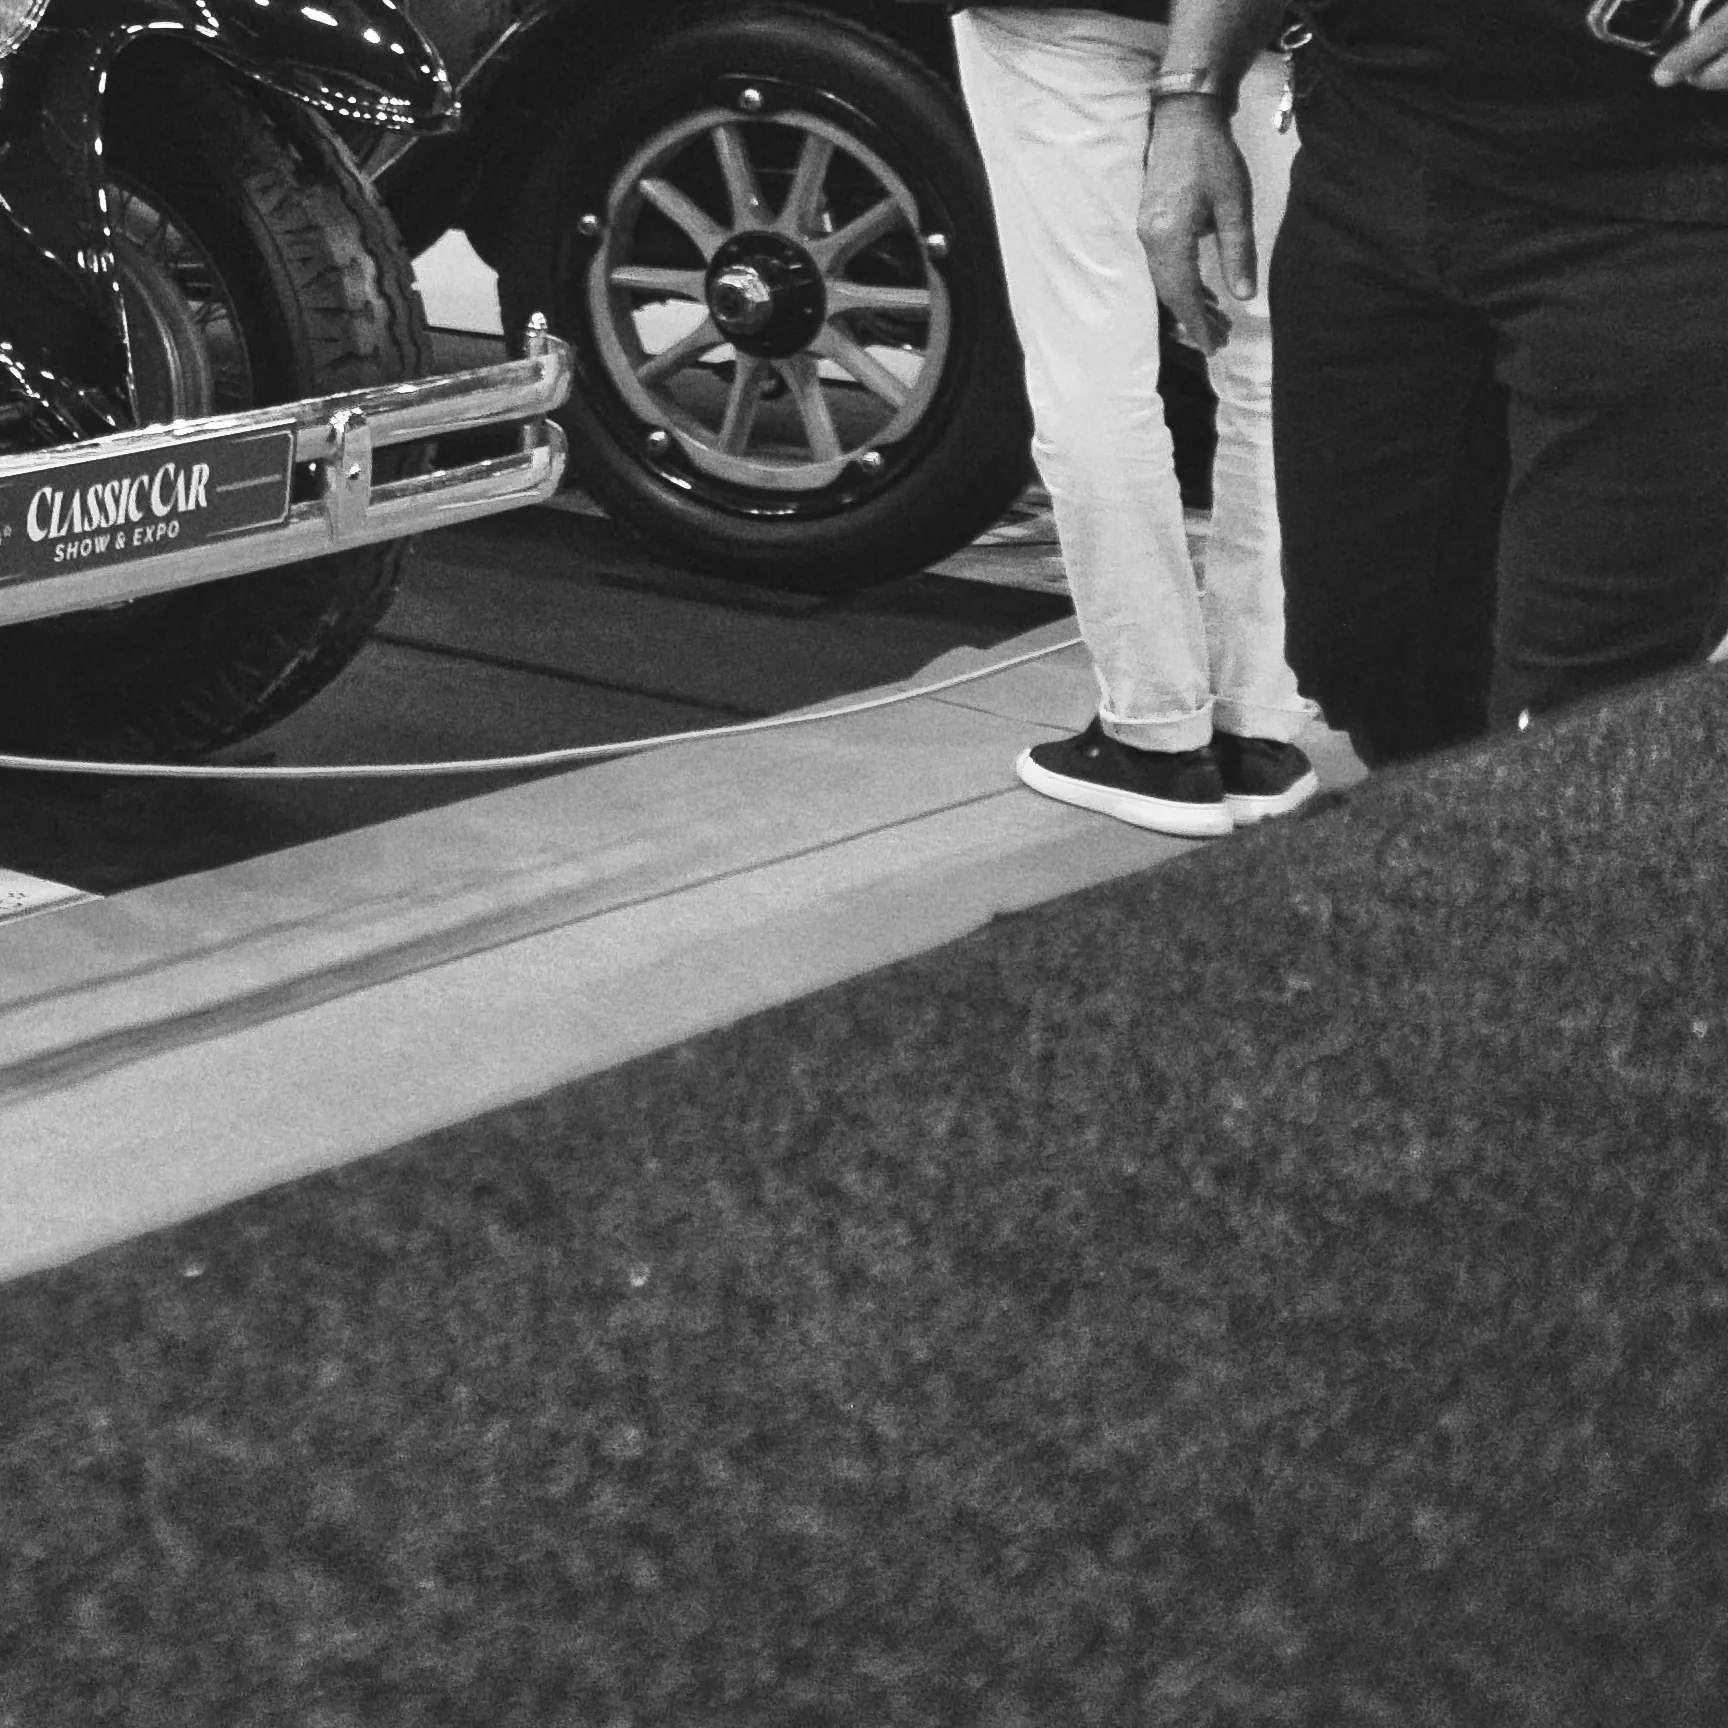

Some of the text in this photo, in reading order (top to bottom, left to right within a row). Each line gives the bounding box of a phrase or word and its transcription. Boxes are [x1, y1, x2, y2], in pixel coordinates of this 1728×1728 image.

[26, 475, 151, 542] CLASSIC
[150, 462, 210, 518] CAR
[53, 521, 180, 562] SHOW & EXPO
